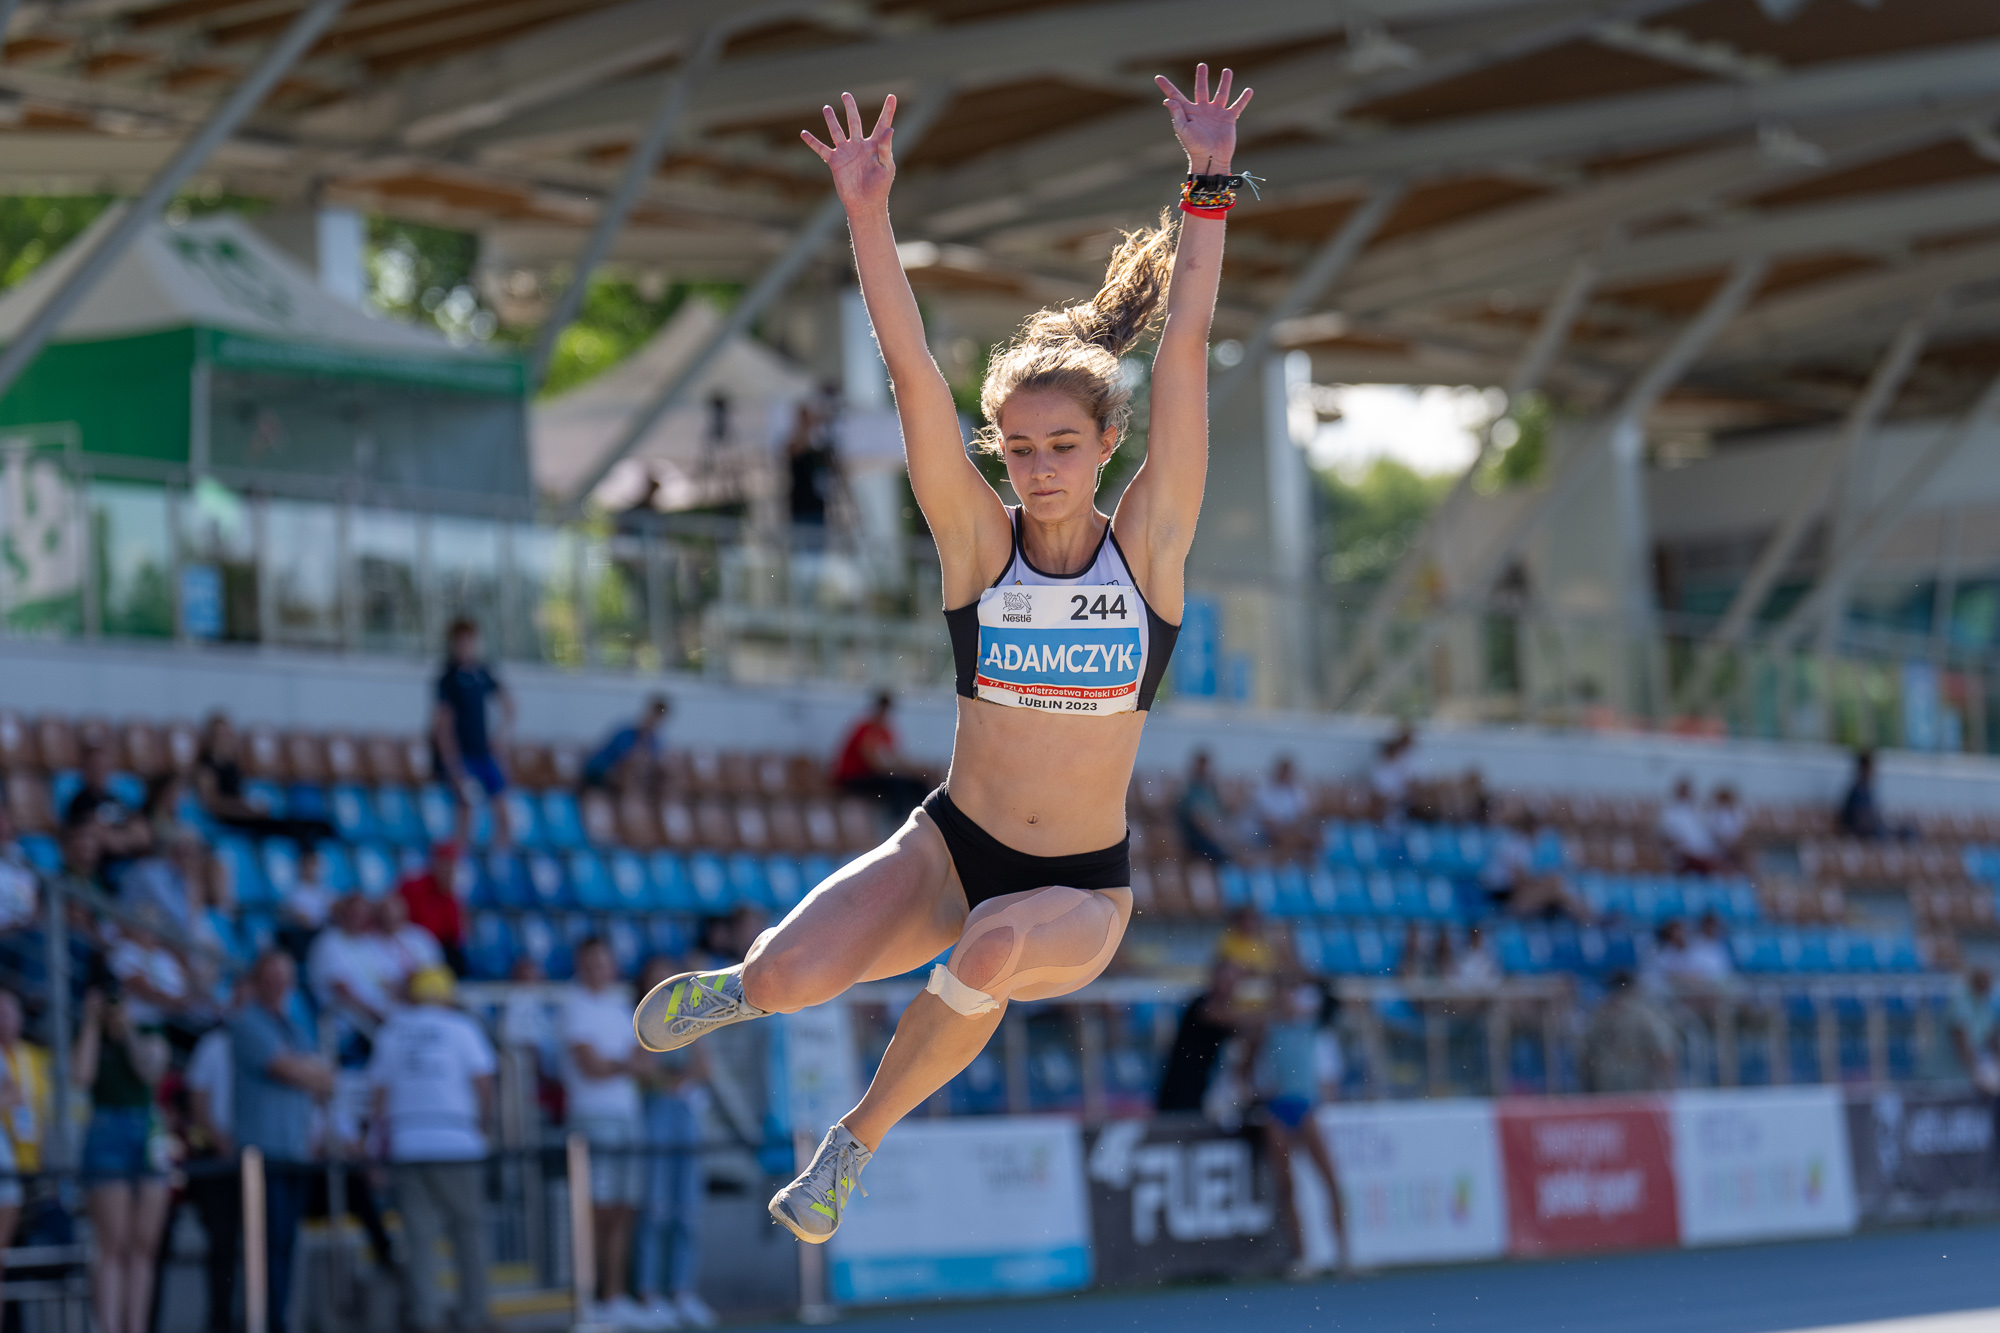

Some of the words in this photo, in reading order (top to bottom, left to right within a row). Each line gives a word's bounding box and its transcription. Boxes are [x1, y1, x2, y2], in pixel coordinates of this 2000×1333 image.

[1070, 594, 1127, 620] 244
[984, 643, 1135, 673] ADAMCZYK
[988, 680, 1001, 688] 77.
[1003, 684, 1025, 694] PZLA
[1026, 687, 1081, 697] Mistrzostwa
[1083, 690, 1110, 698] Polski
[1112, 686, 1129, 697] U20
[1018, 696, 1063, 710] LUBLIN
[1065, 701, 1098, 711] 2023
